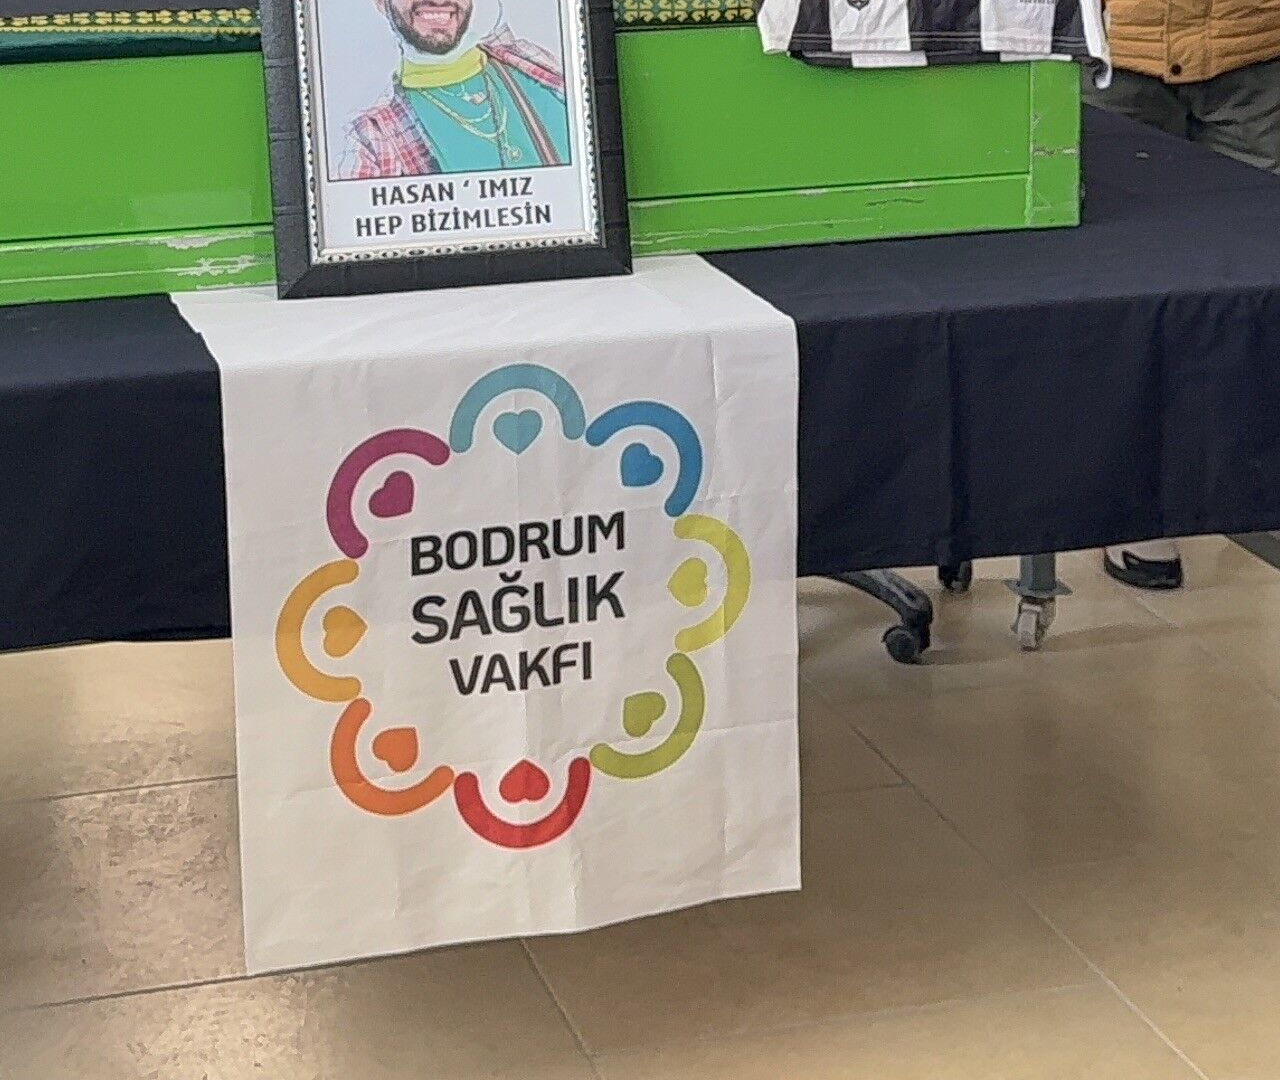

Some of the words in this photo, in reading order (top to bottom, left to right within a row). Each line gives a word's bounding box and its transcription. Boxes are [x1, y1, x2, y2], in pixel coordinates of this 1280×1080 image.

[356, 215, 403, 237] HEP
[412, 201, 552, 234] BİZİMLESİN
[371, 180, 455, 207] HASAN
[479, 176, 534, 199] IMIZ
[411, 511, 626, 577] BODRUM
[411, 570, 626, 645] SAĞLIK
[449, 640, 592, 697] VAKFI
